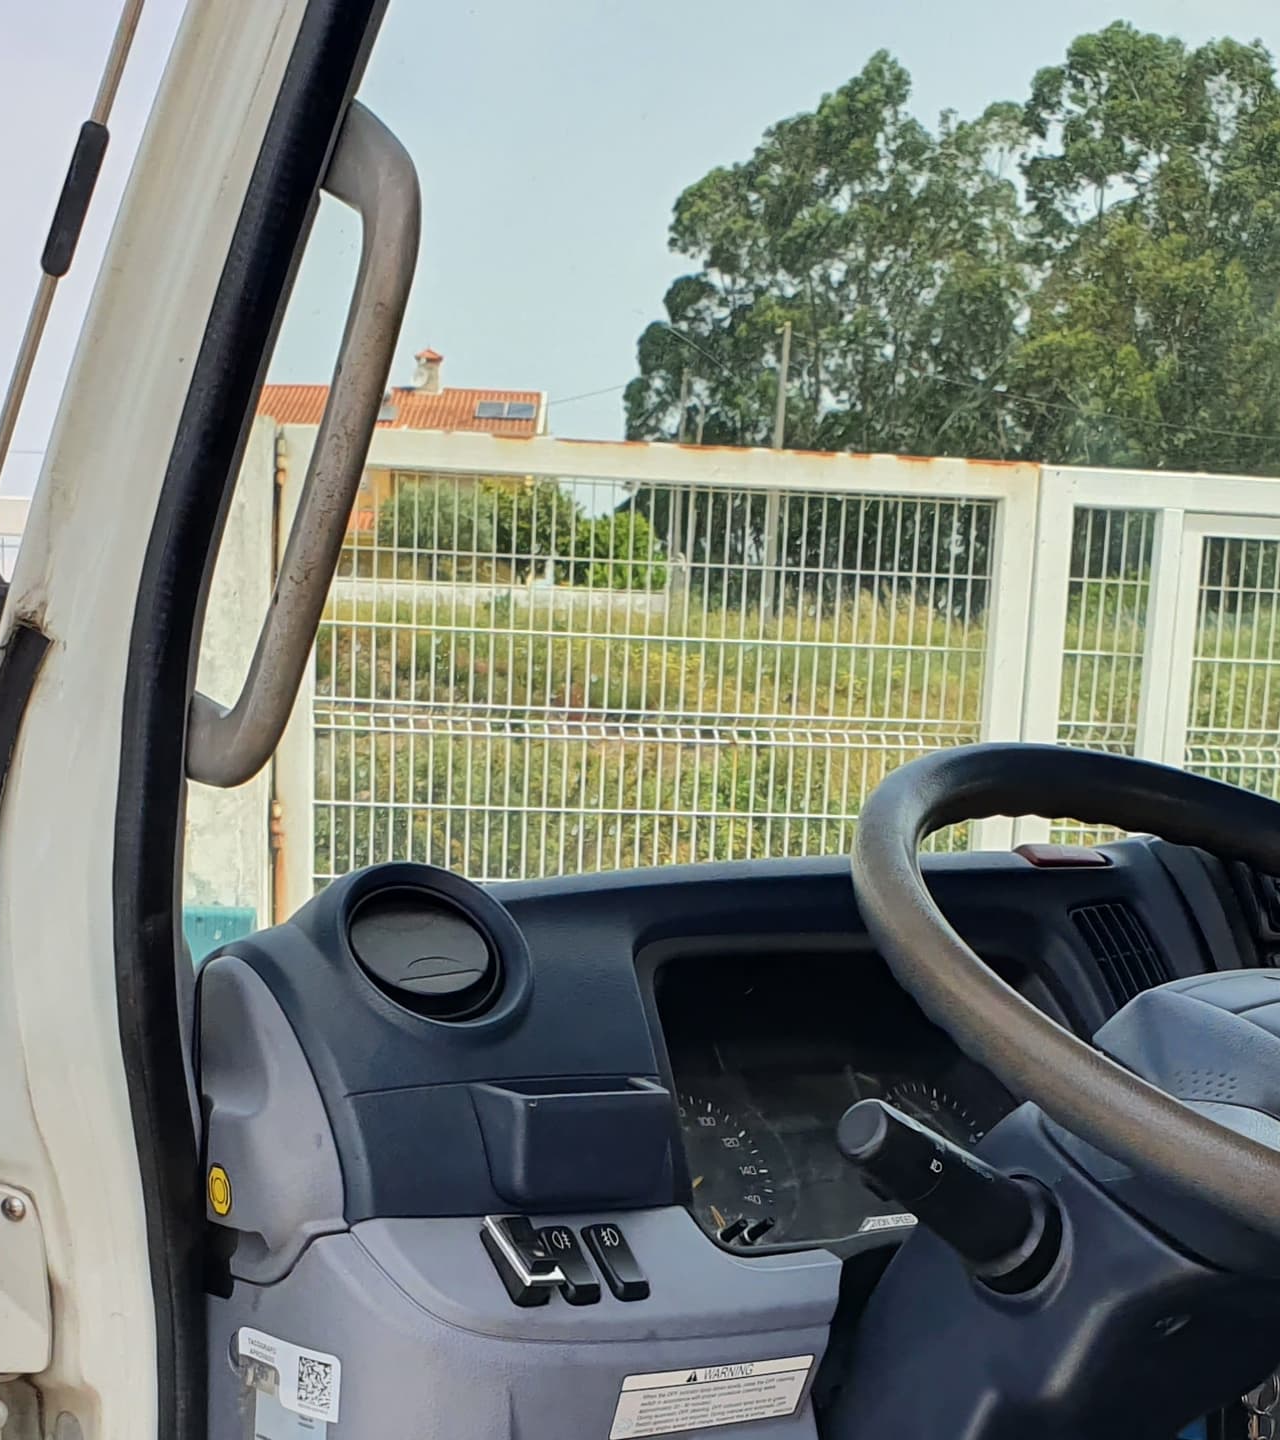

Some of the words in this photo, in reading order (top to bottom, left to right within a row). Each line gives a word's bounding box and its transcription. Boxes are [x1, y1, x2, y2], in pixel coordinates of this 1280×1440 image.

[697, 1116, 716, 1127] 100
[721, 1137, 740, 1148] 120
[739, 1165, 758, 1175] 140
[704, 1363, 754, 1380] WARNING
